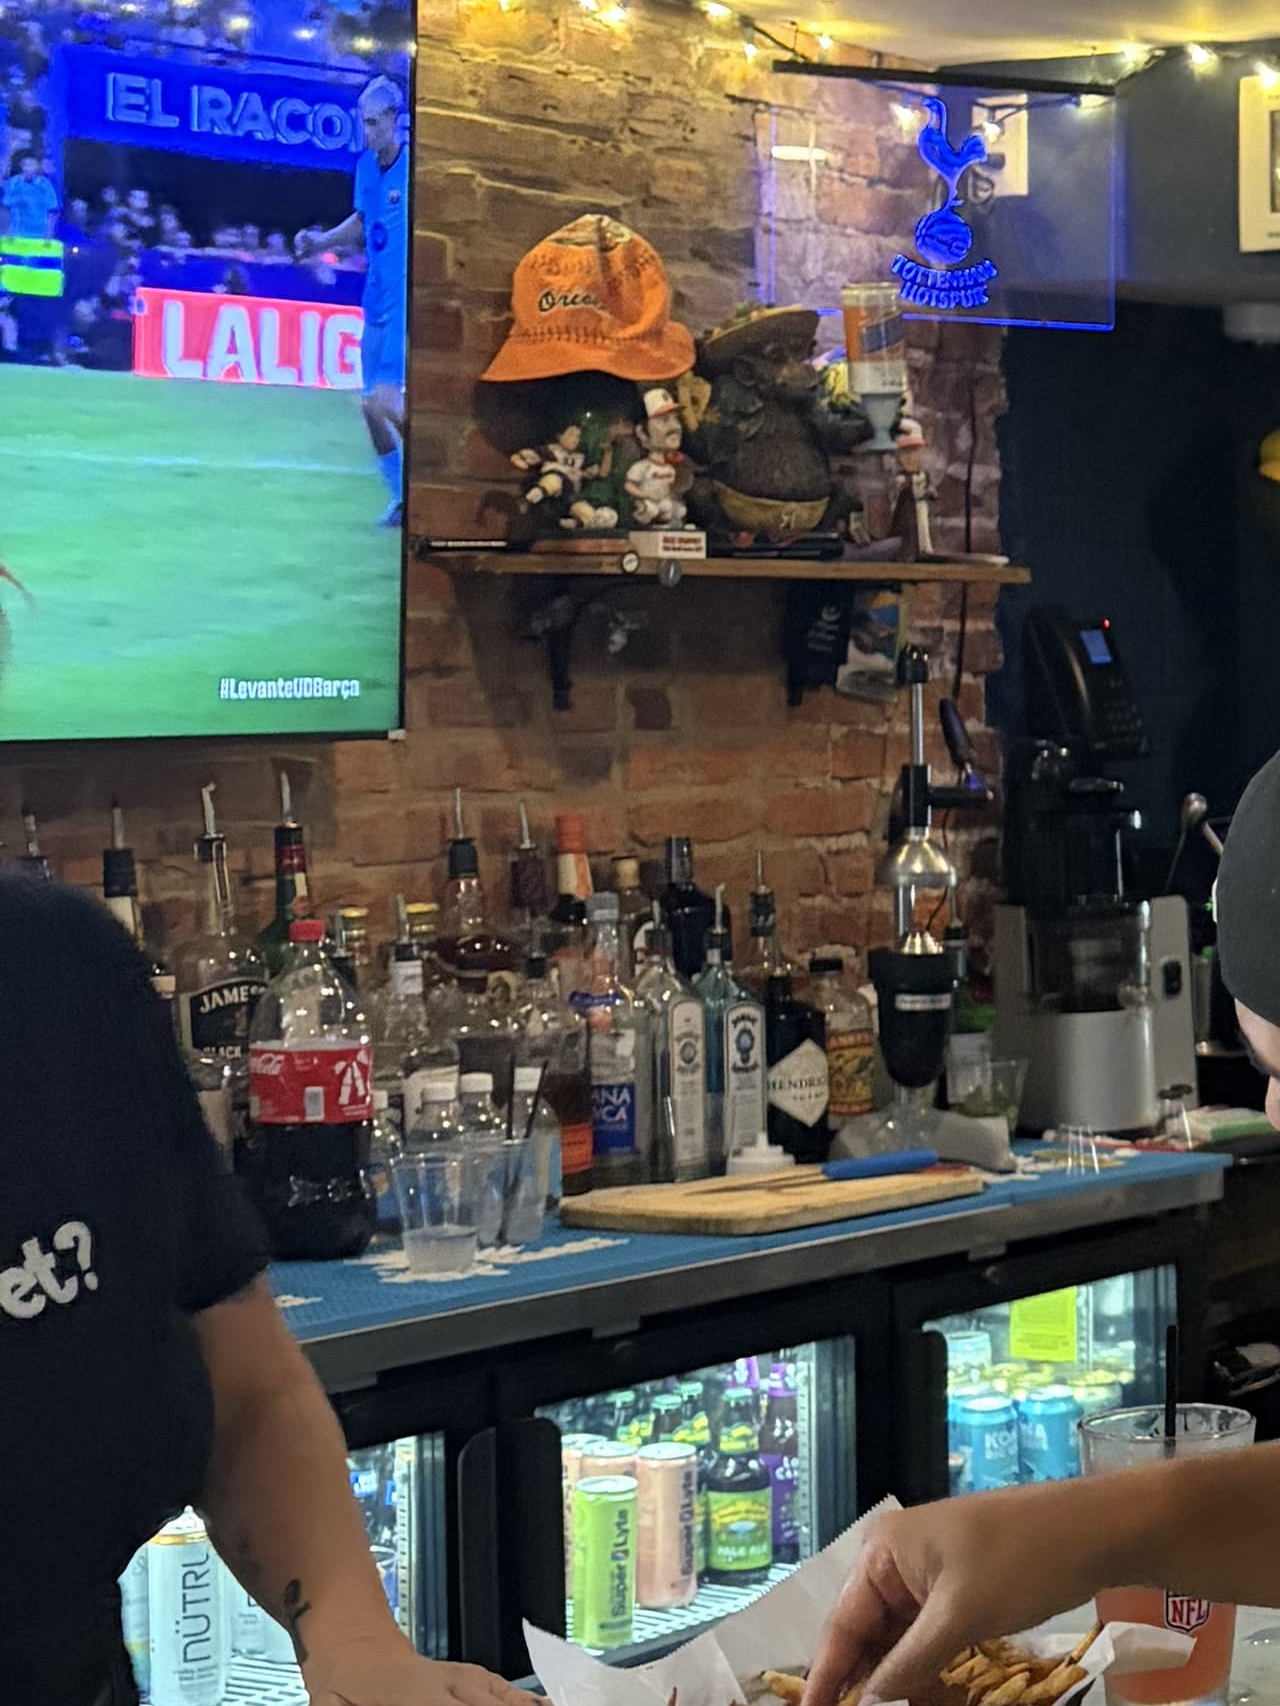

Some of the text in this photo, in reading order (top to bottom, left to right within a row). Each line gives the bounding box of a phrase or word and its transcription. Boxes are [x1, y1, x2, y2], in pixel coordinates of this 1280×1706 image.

[106, 71, 179, 128] EL
[890, 253, 998, 290] TOTTENHAM
[898, 280, 990, 310] HOTSPUR
[161, 300, 364, 390] LALIG
[219, 677, 361, 700] #LevanteUDBarça
[1171, 1597, 1205, 1627] NFL
